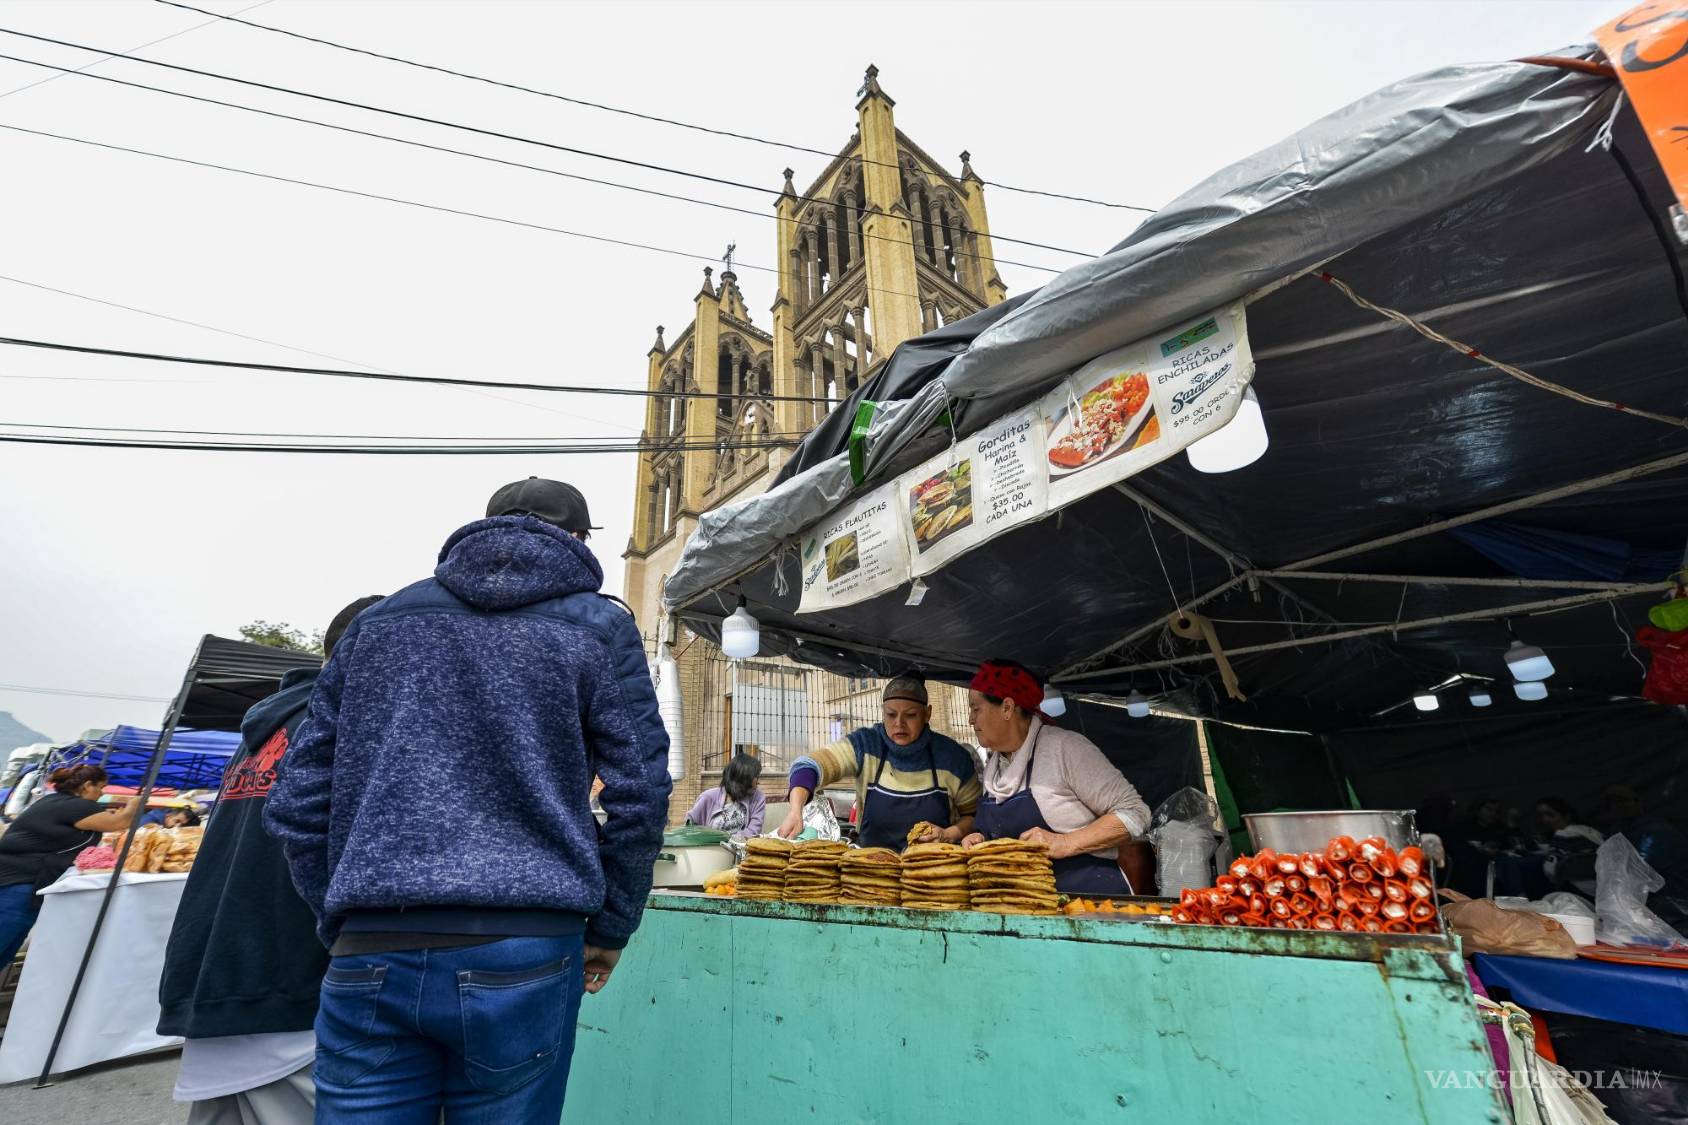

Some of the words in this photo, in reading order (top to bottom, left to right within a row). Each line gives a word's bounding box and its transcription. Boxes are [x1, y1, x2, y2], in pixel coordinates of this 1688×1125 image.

[1157, 342, 1234, 384] ENCHILADAS
[1172, 346, 1211, 368] RICAS
[1173, 406, 1204, 428] $95.00
[1193, 410, 1213, 425] CON
[978, 420, 1031, 453] Gorditas
[984, 441, 1015, 461] Harina
[1019, 434, 1026, 443] &
[994, 450, 1017, 466] Maíz
[986, 508, 1008, 524] CADA
[1012, 499, 1033, 512] UNA
[992, 492, 1024, 511] $35.00
[823, 524, 843, 539] RICAS
[845, 501, 887, 528] FLAUTITAS
